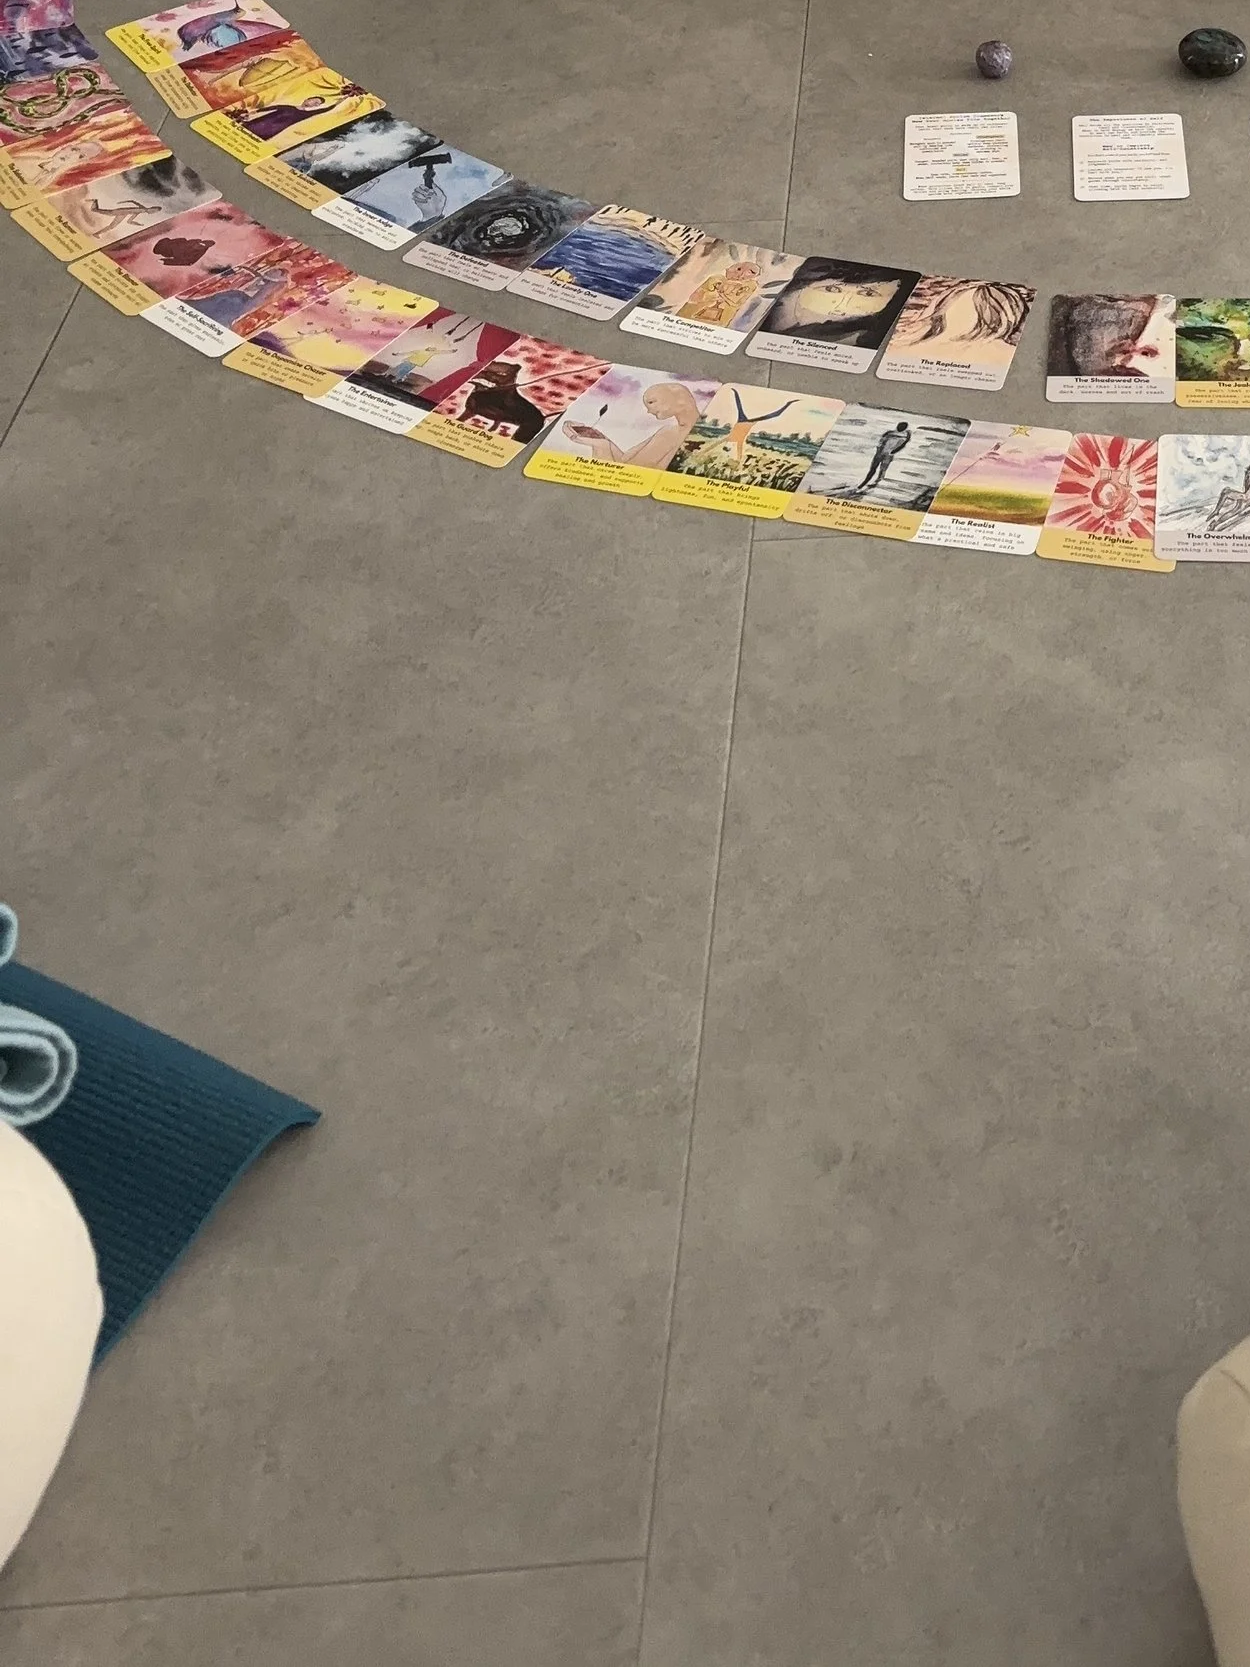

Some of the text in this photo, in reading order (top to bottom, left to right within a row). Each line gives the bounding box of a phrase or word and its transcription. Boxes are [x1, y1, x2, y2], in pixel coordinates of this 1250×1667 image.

[459, 254, 489, 267] Defeated
[561, 284, 583, 294] Lonely
[662, 315, 715, 332] The Competitor
[807, 341, 838, 351] Silenced
[260, 348, 327, 376] The Dopamine Chaser
[935, 361, 971, 369] Replaced
[349, 385, 398, 407] The Entertainer
[444, 418, 493, 441] The Guard Dog
[574, 456, 626, 470] The Nurturer
[706, 479, 751, 492] The Playful
[826, 498, 893, 514] The Disconnector
[967, 520, 996, 529] Realist
[1088, 533, 1135, 545] The Fighter
